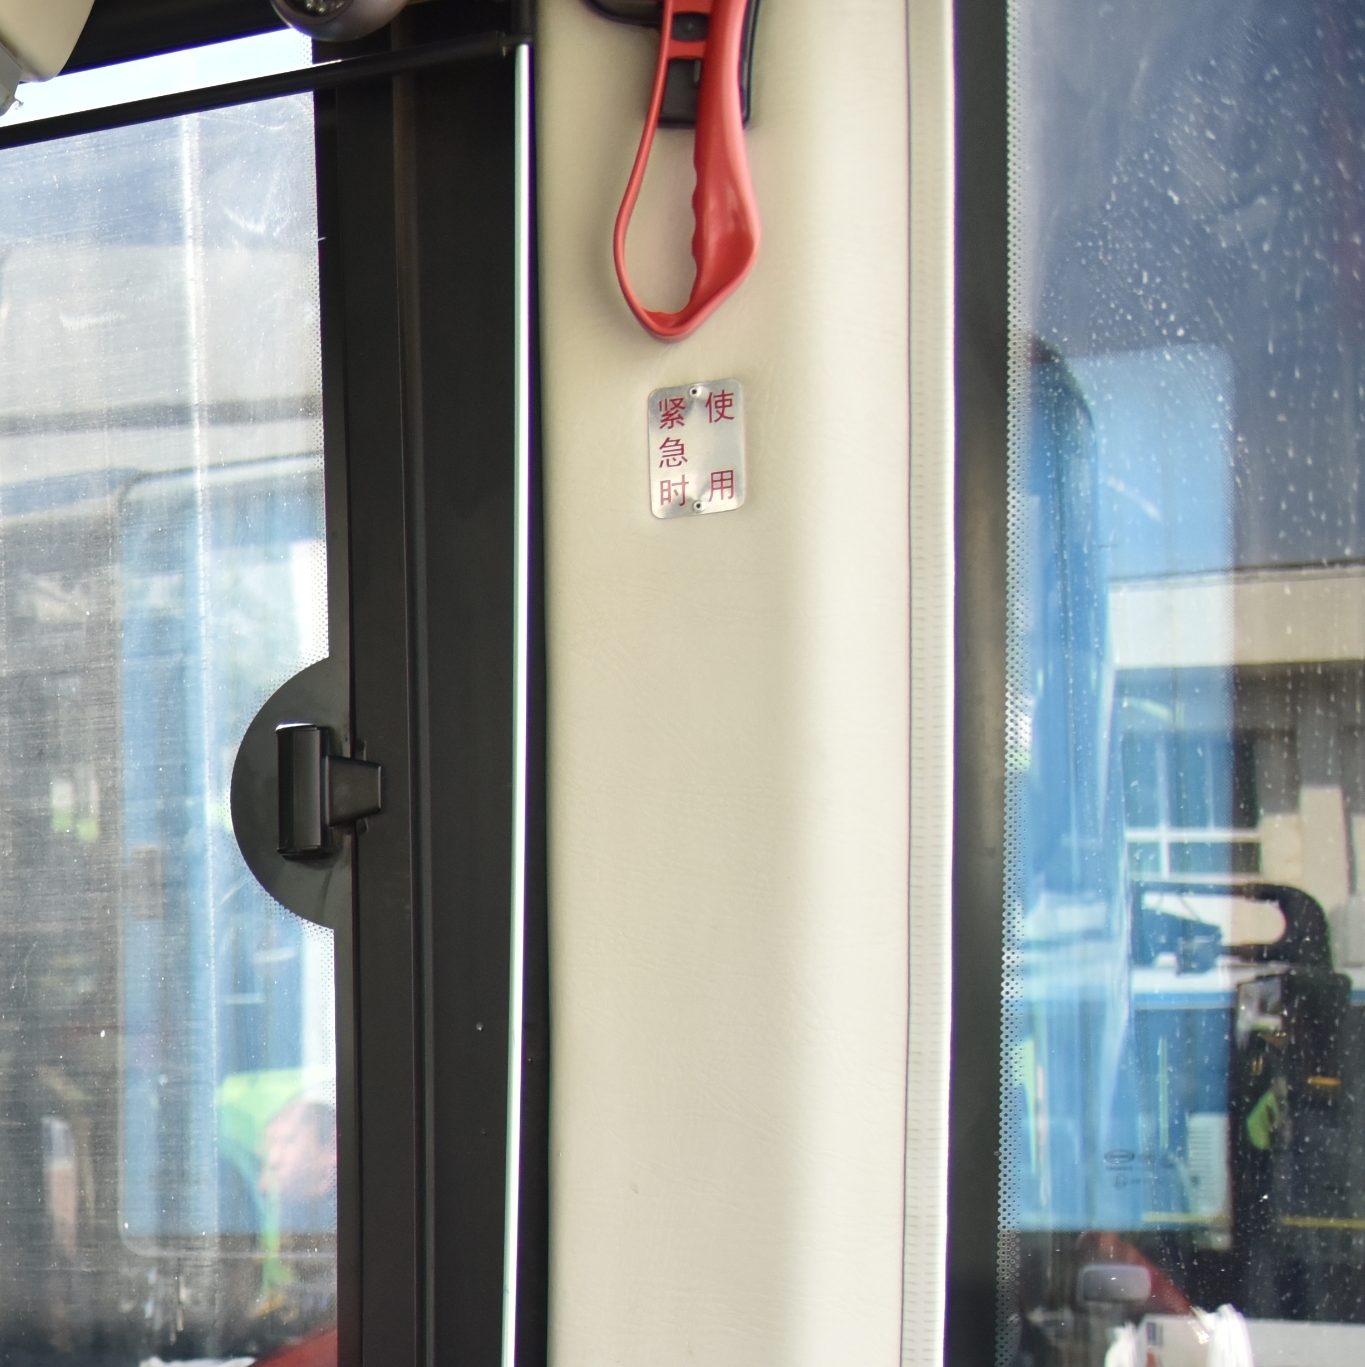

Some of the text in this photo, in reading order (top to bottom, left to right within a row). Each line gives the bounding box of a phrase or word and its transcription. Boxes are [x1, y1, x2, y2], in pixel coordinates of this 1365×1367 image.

[658, 397, 690, 507] 紧急时
[705, 389, 735, 503] 使用
